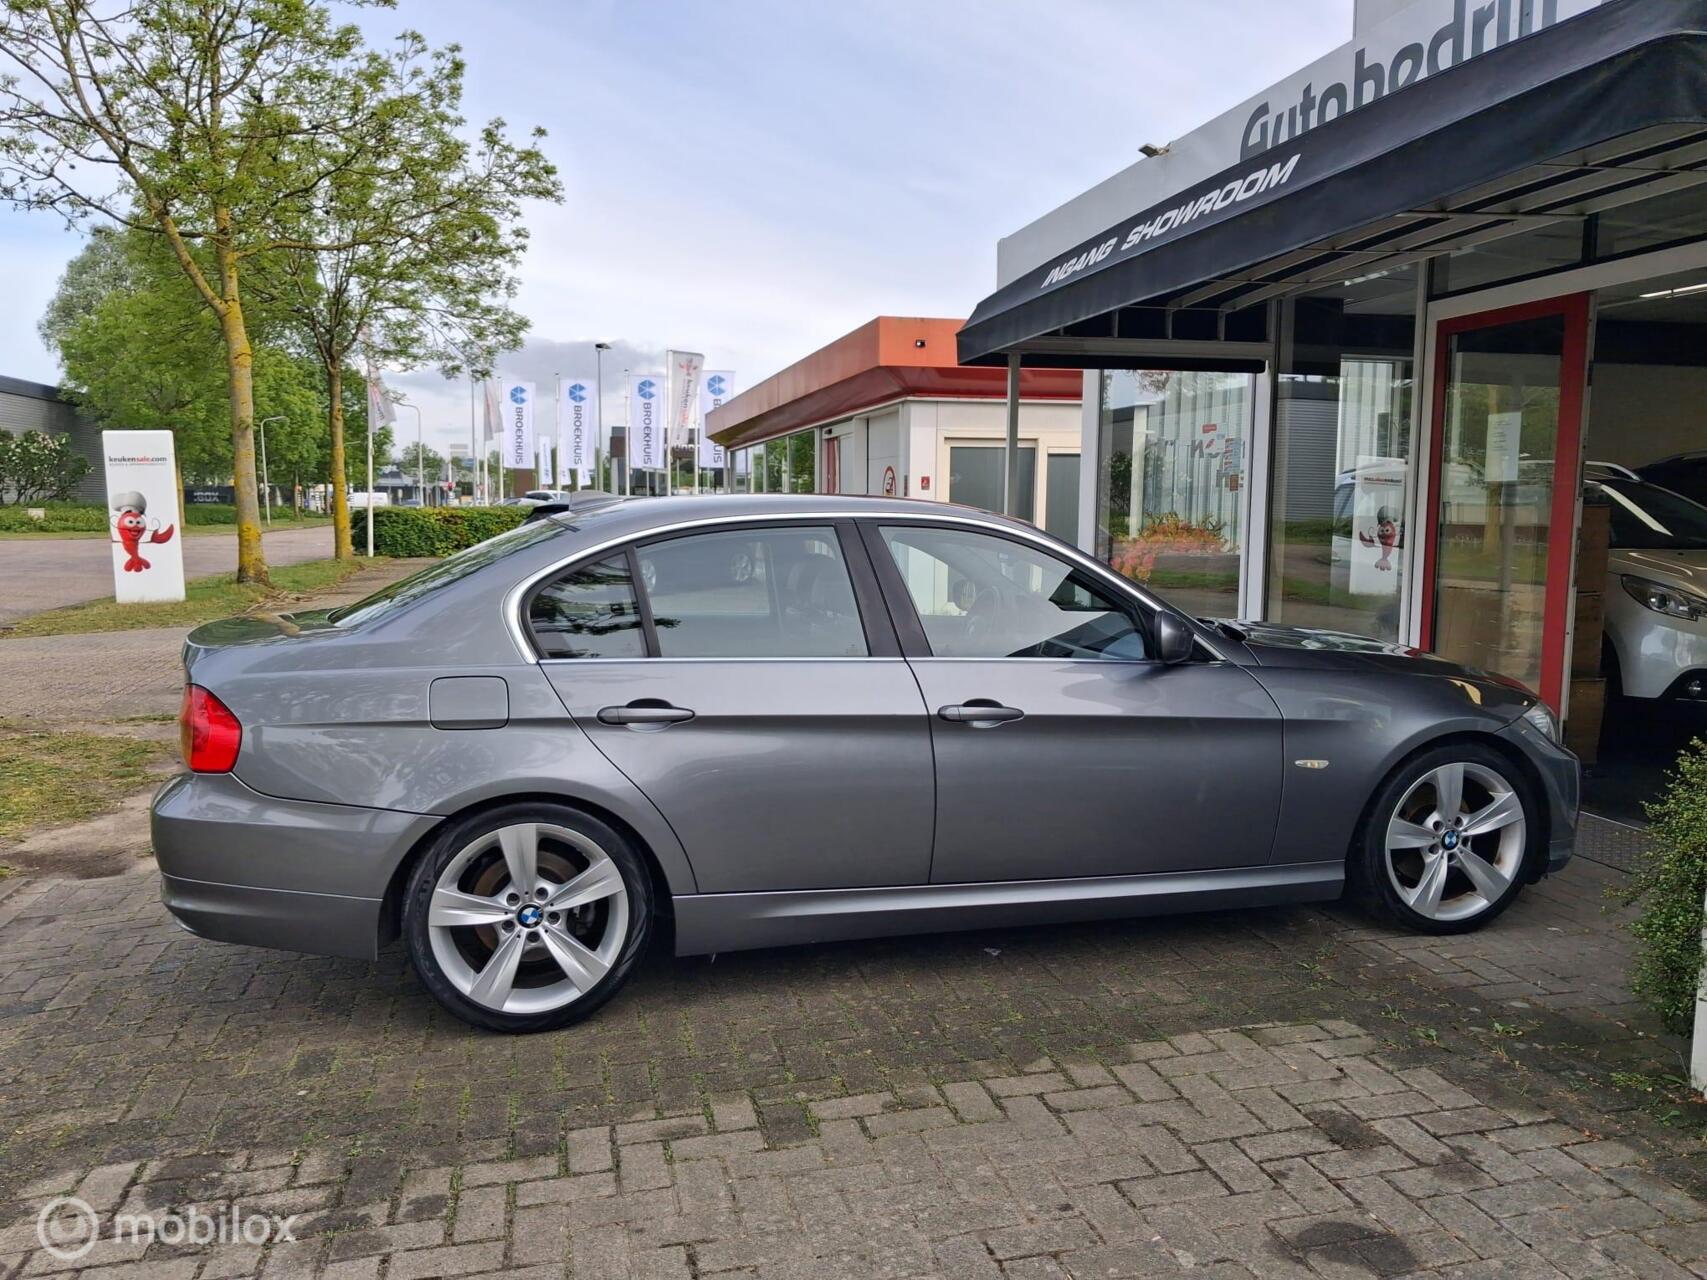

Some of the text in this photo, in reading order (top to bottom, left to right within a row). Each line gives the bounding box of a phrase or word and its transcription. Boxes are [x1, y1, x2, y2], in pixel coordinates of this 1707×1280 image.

[1240, 0, 1557, 160] Autobedri
[1041, 153, 1302, 289] INGANG SHOWROOM
[108, 455, 168, 463] keukensale.com
[515, 407, 523, 465] BROEKHUIS
[573, 405, 582, 465] BROEKHUIS
[643, 402, 652, 465] BROEKHUIS
